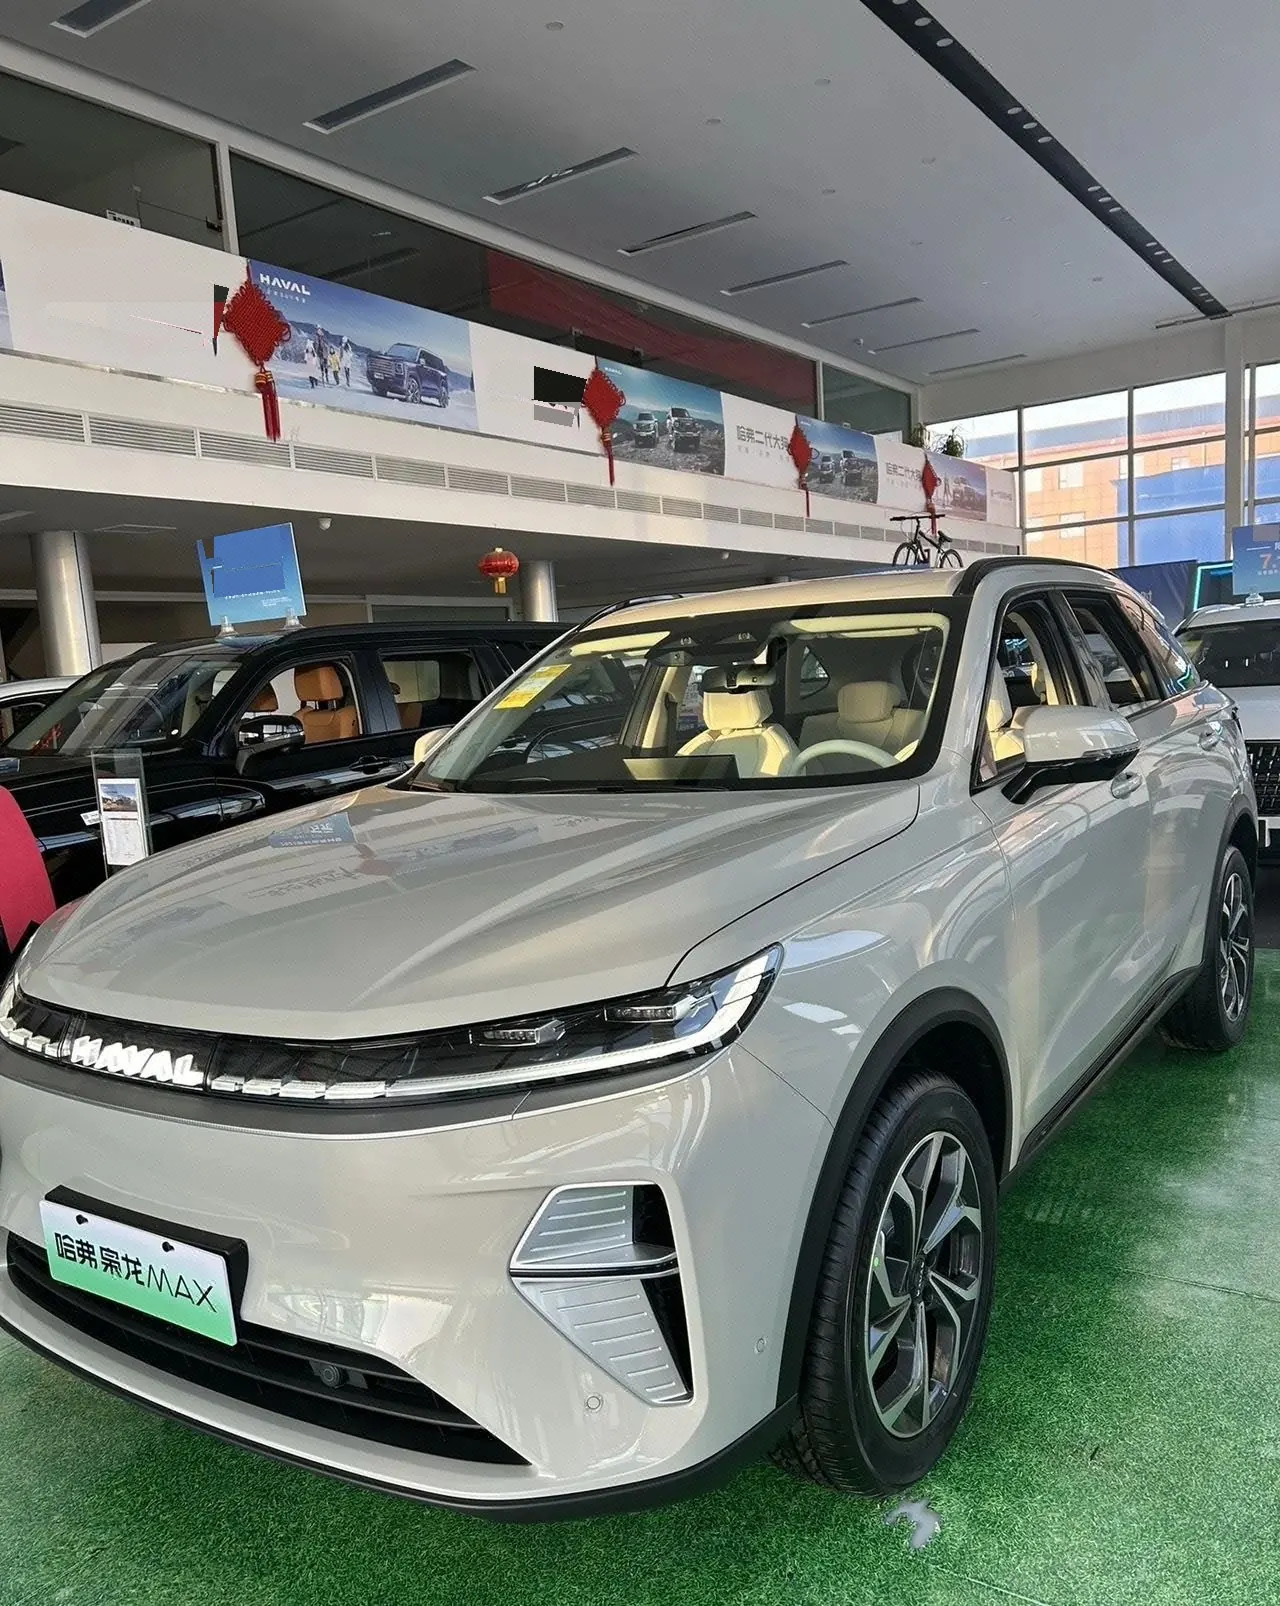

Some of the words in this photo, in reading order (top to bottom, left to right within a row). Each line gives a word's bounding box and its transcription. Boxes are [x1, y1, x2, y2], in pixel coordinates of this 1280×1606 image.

[260, 273, 311, 296] HAVAL
[71, 1035, 204, 1087] HAVAL
[54, 1232, 217, 1313] 哈弗枭龙MAX
